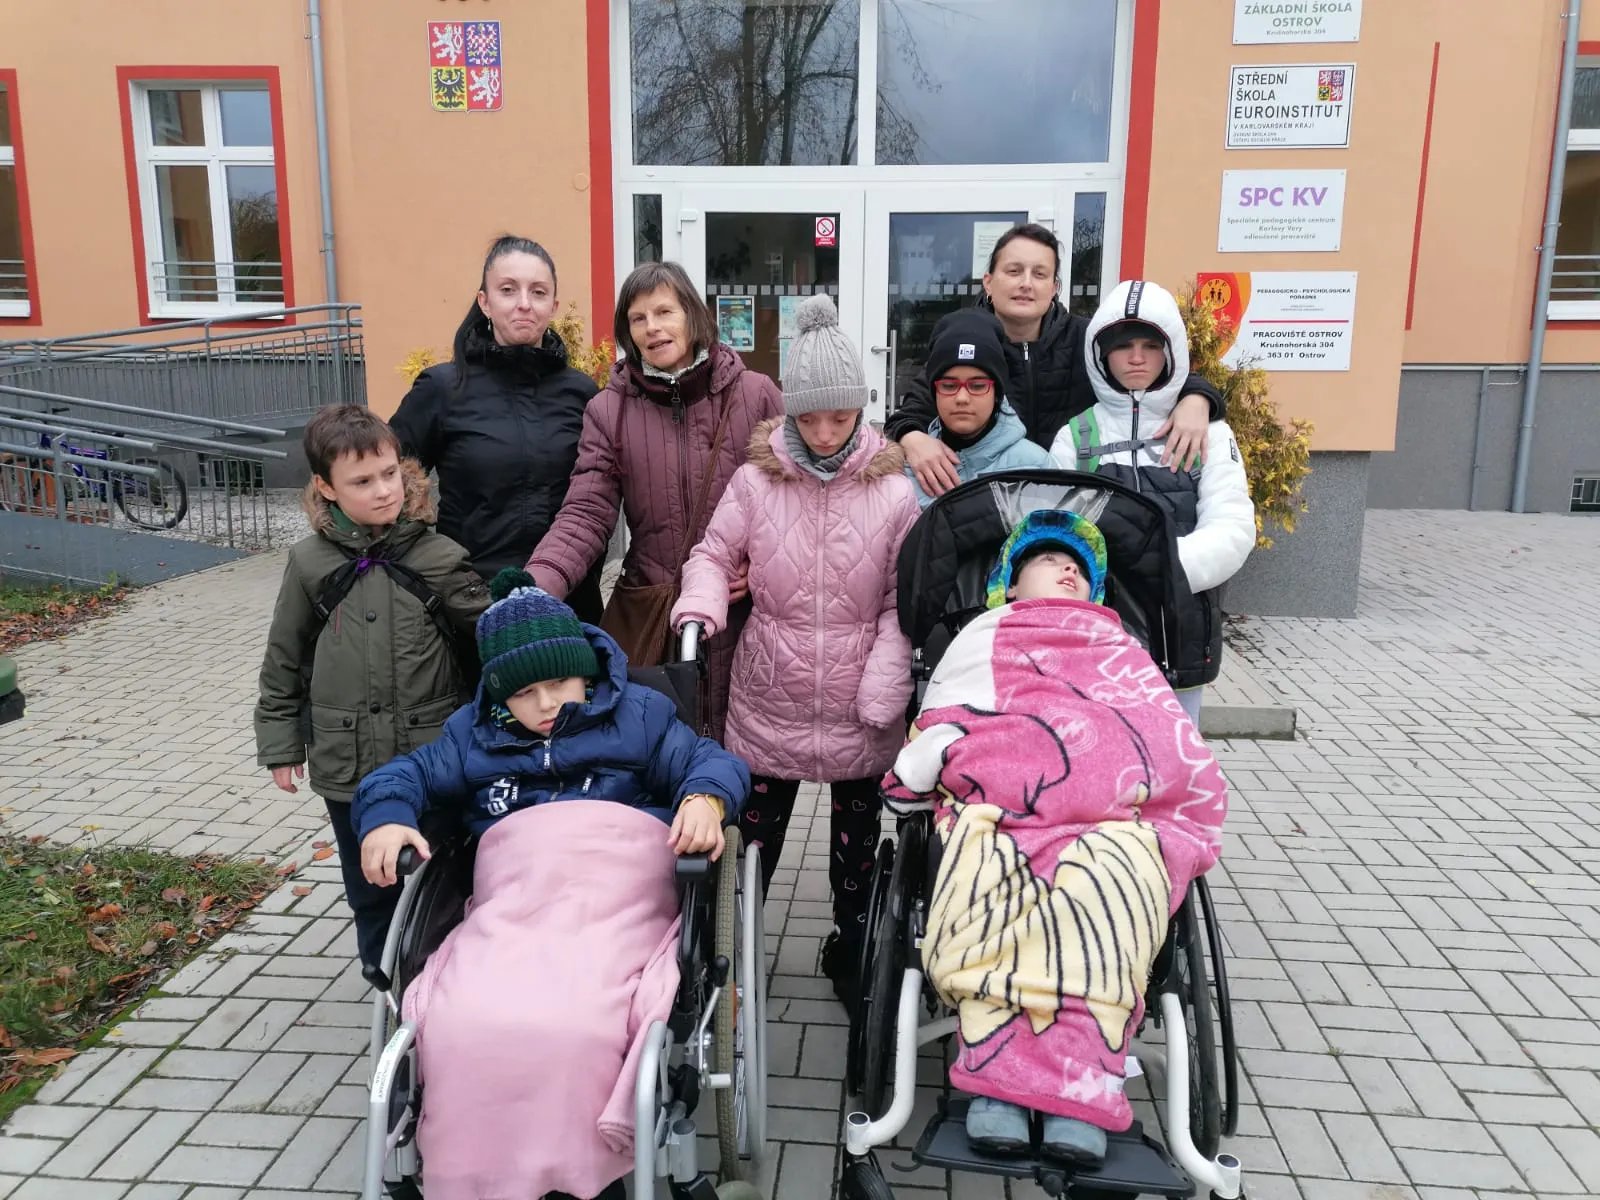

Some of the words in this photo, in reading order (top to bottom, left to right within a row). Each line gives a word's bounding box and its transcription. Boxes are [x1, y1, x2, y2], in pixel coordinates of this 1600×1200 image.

[1244, 2, 1308, 15] ZÁKLADNÍ
[1312, 1, 1353, 13] ŠKOLA
[1272, 16, 1323, 27] OSTROV
[1237, 70, 1289, 85] STŘEDNÍ
[1235, 88, 1276, 102] ŠKOLA
[1234, 104, 1343, 119] EUROINSTITUT
[1238, 186, 1285, 208] SPC
[1292, 186, 1329, 207] KV
[1308, 330, 1344, 338] OSTROV
[1298, 351, 1327, 359] Ostrov
